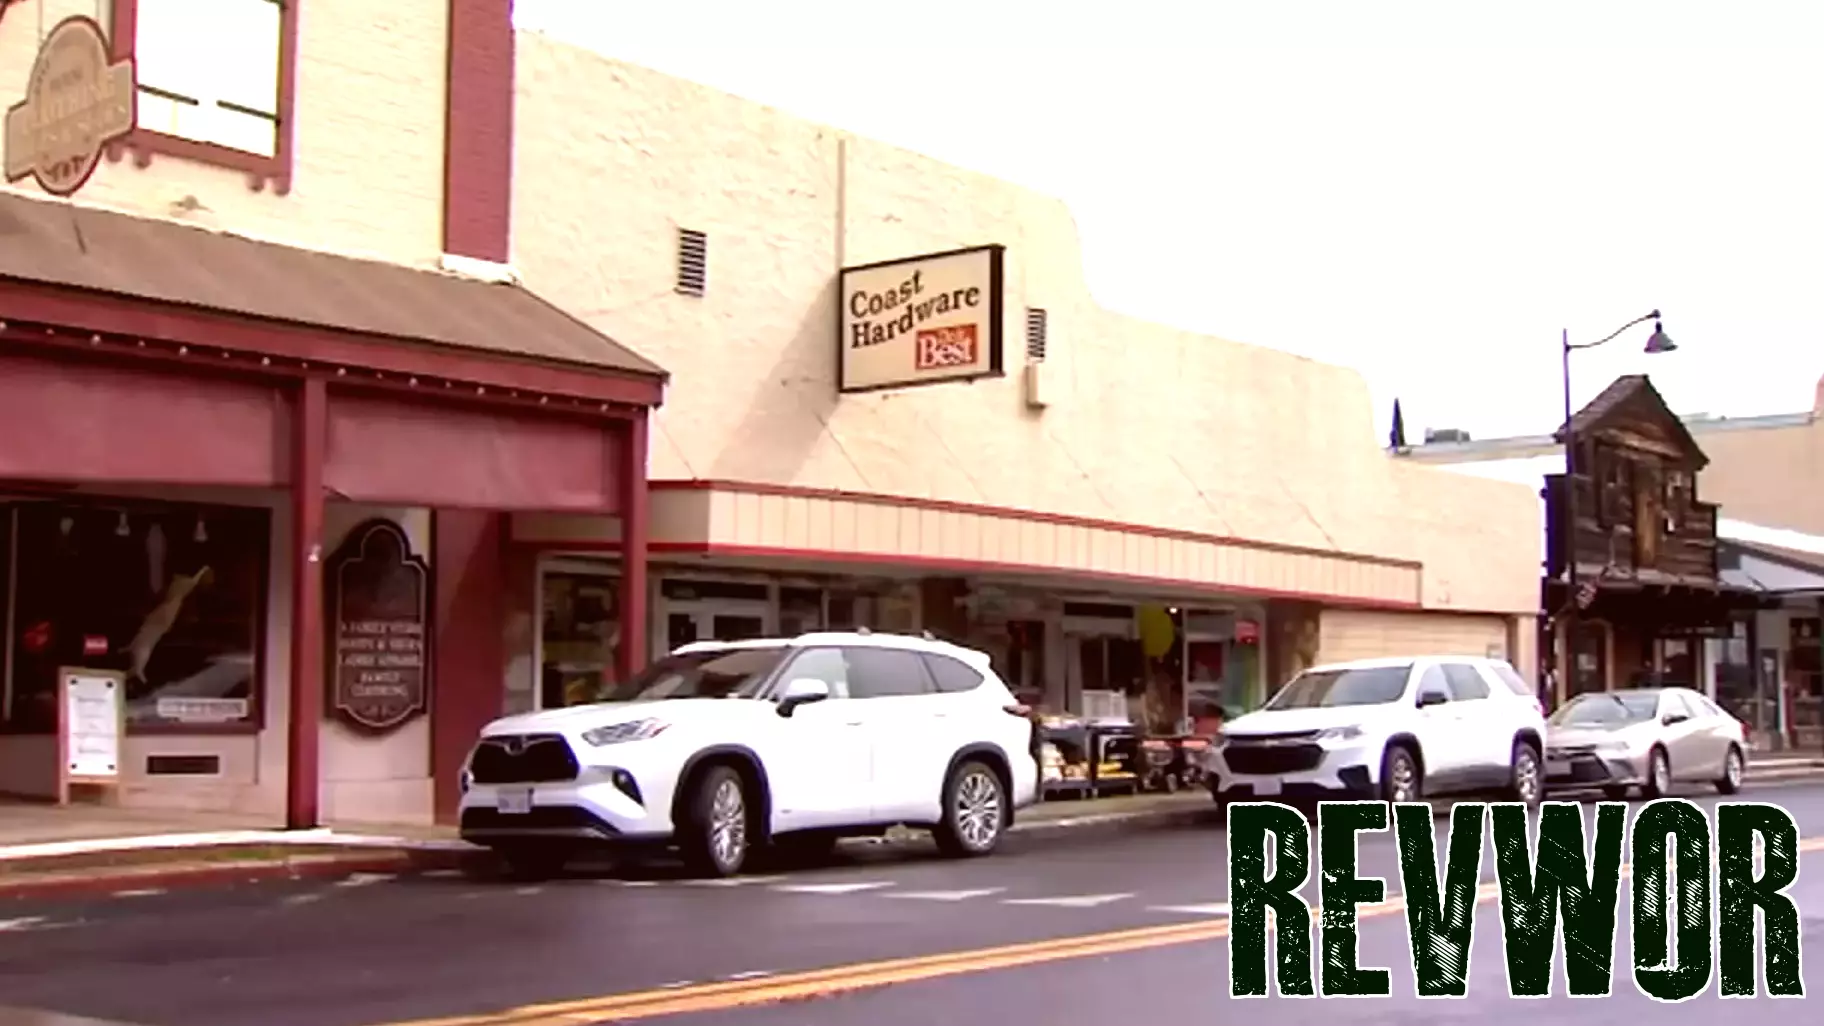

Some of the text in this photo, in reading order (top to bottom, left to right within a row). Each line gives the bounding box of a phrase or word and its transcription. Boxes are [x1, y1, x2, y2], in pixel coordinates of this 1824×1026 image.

[850, 269, 924, 318] Coast
[851, 286, 980, 348] Hardware
[919, 333, 973, 367] Best
